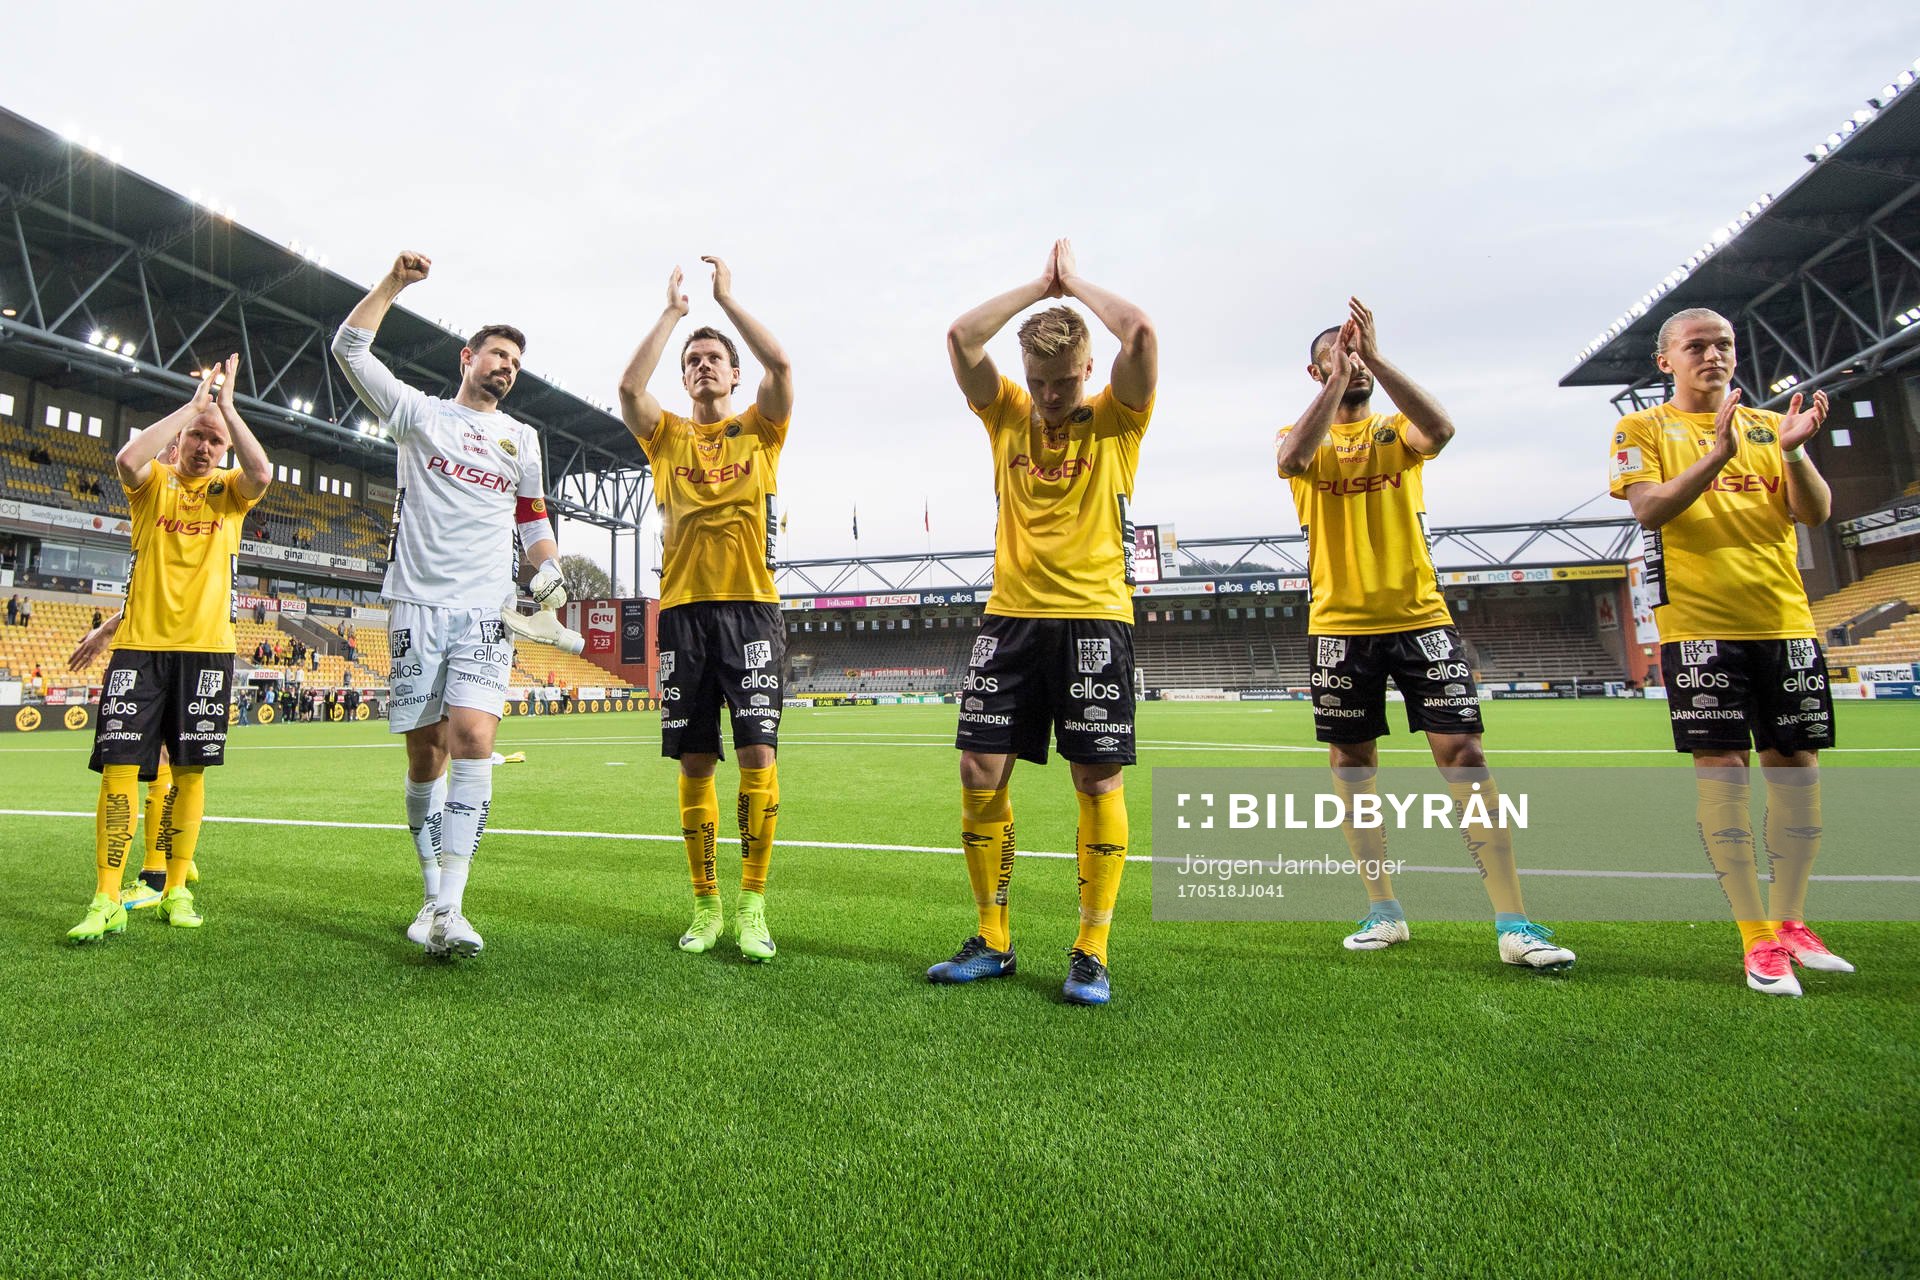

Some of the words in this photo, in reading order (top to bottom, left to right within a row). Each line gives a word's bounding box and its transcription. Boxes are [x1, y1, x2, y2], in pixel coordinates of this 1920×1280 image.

[426, 456, 511, 493] PULSEN
[674, 461, 750, 484] PULSEN
[1318, 472, 1401, 496] PULSEN
[1218, 582, 1243, 593] ellos
[1250, 580, 1275, 592] ellos
[870, 596, 918, 605] PULSEN
[924, 594, 944, 604] ellos
[950, 592, 972, 603] ellos
[282, 601, 305, 609] SPEED
[591, 613, 613, 624] City
[1421, 632, 1441, 644] EFF
[746, 642, 765, 652] EFF
[1080, 641, 1104, 650] EFF
[1320, 640, 1340, 649] EFF
[1425, 640, 1447, 652] EKT
[1684, 645, 1713, 653] EKT
[474, 645, 509, 666] ellos
[747, 651, 768, 660] EKT
[1081, 651, 1107, 660] EKT
[1320, 648, 1343, 658] EKT
[1686, 654, 1700, 663] IV
[1791, 648, 1814, 657] EKT
[1081, 661, 1095, 670] IV
[1792, 658, 1805, 667] IV
[389, 661, 422, 680] ellos
[1426, 662, 1468, 680] ellos
[741, 670, 778, 688] ellos
[963, 670, 998, 692] ellos
[1312, 668, 1352, 689] ellos
[1676, 667, 1729, 688] ellos
[1783, 671, 1824, 692] ellos
[1070, 677, 1120, 700] ellos
[102, 697, 137, 715] ellos
[188, 698, 224, 716] ellos
[1672, 709, 1744, 720] JÄRNGRINDEN
[1065, 720, 1132, 734] JÄRNGRINDEN
[106, 793, 133, 868] SPRINGYARD
[701, 822, 716, 881] SPRINGYARD
[996, 823, 1015, 906] SPRINGYARD
